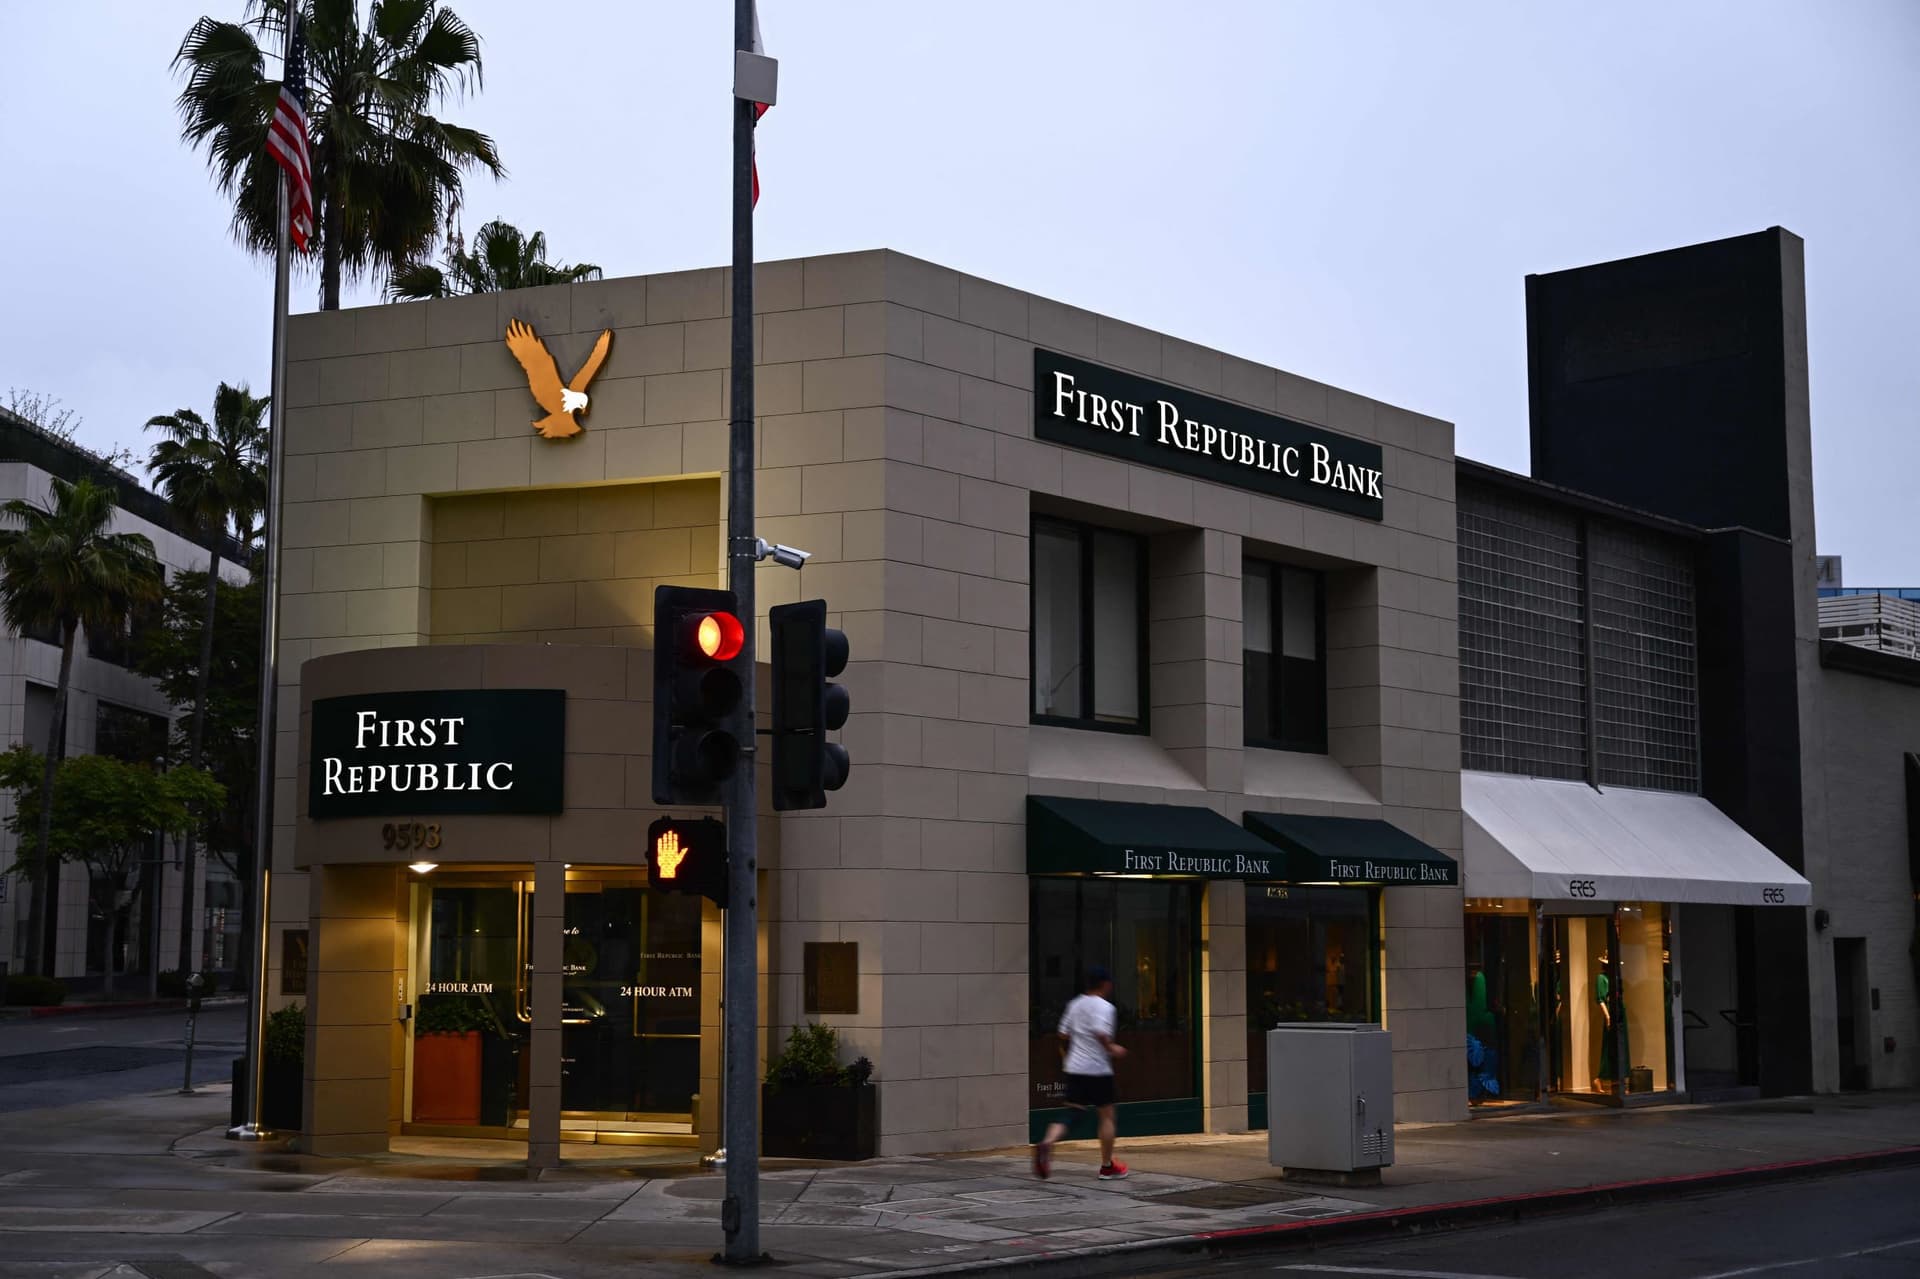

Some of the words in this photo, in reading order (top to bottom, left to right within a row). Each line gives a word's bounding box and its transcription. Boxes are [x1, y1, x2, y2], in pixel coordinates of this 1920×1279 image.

[1053, 371, 1143, 437] FIRST
[1157, 400, 1300, 478] REPUBLIC
[1309, 442, 1382, 499] BANK
[356, 711, 465, 748] FIRST
[322, 757, 514, 795] REPUBLIC
[383, 823, 441, 849] 9593
[1125, 849, 1163, 870] FIRST
[1168, 851, 1231, 873] REPUBLIC
[1236, 854, 1270, 874] BANK
[1330, 859, 1361, 878] FIRST
[1365, 861, 1417, 880] REPUBLIC
[1420, 863, 1449, 881] BANK
[1570, 880, 1596, 898] ERES
[1763, 887, 1785, 903] ERES
[425, 982, 437, 993] 24
[438, 982, 469, 993] HOUR
[470, 983, 493, 993] ATM
[620, 986, 633, 997] 24
[634, 986, 666, 998] HOUR
[668, 986, 693, 998] ATM
